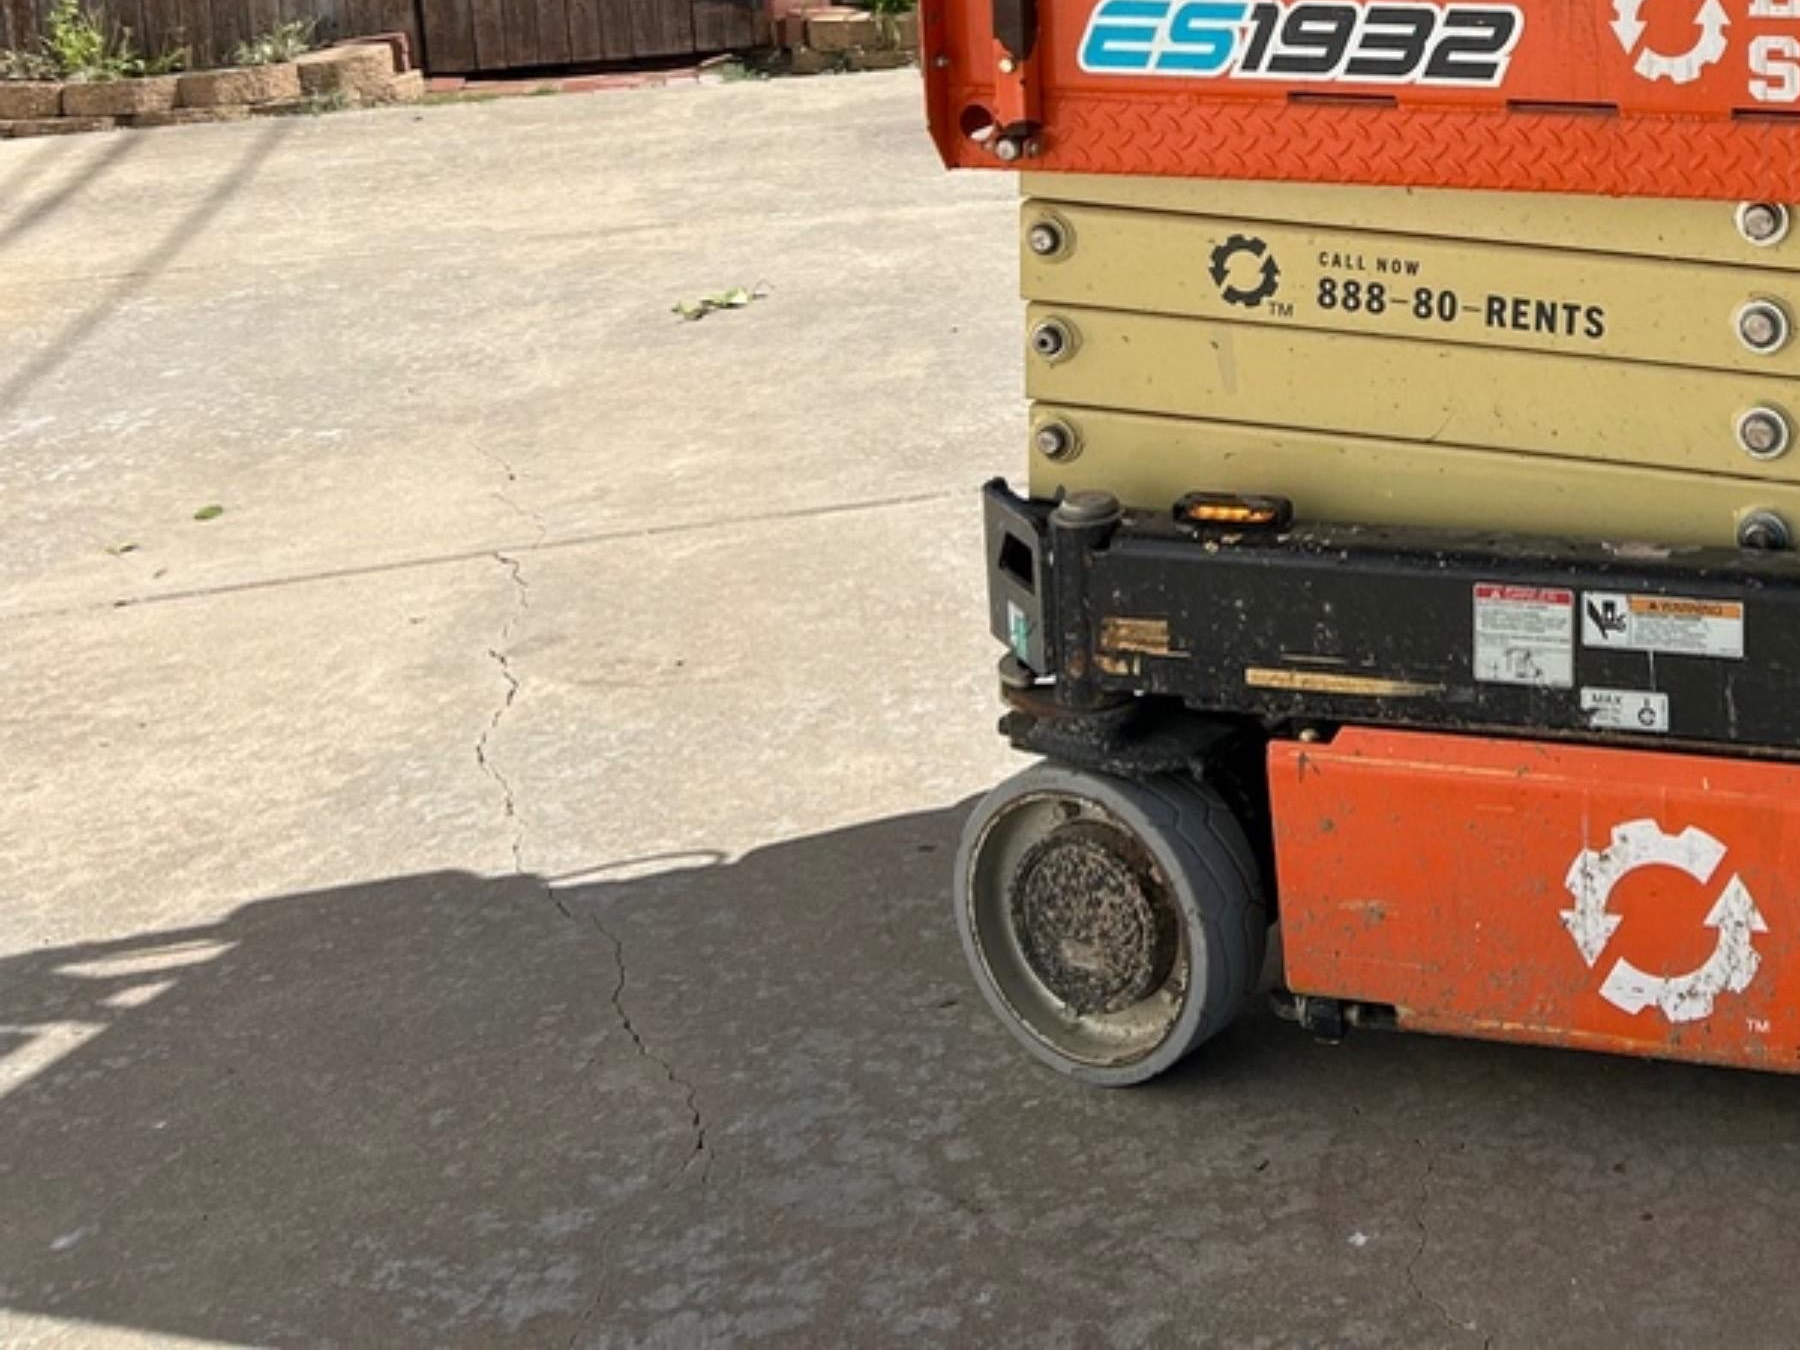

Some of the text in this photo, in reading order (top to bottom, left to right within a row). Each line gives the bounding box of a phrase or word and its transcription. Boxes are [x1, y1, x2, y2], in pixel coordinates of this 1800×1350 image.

[1318, 251, 1420, 276] CALL NOW
[1268, 302, 1294, 317] TM
[1316, 277, 1606, 339] 888-80-RENTS
[1746, 1017, 1771, 1034] TM
